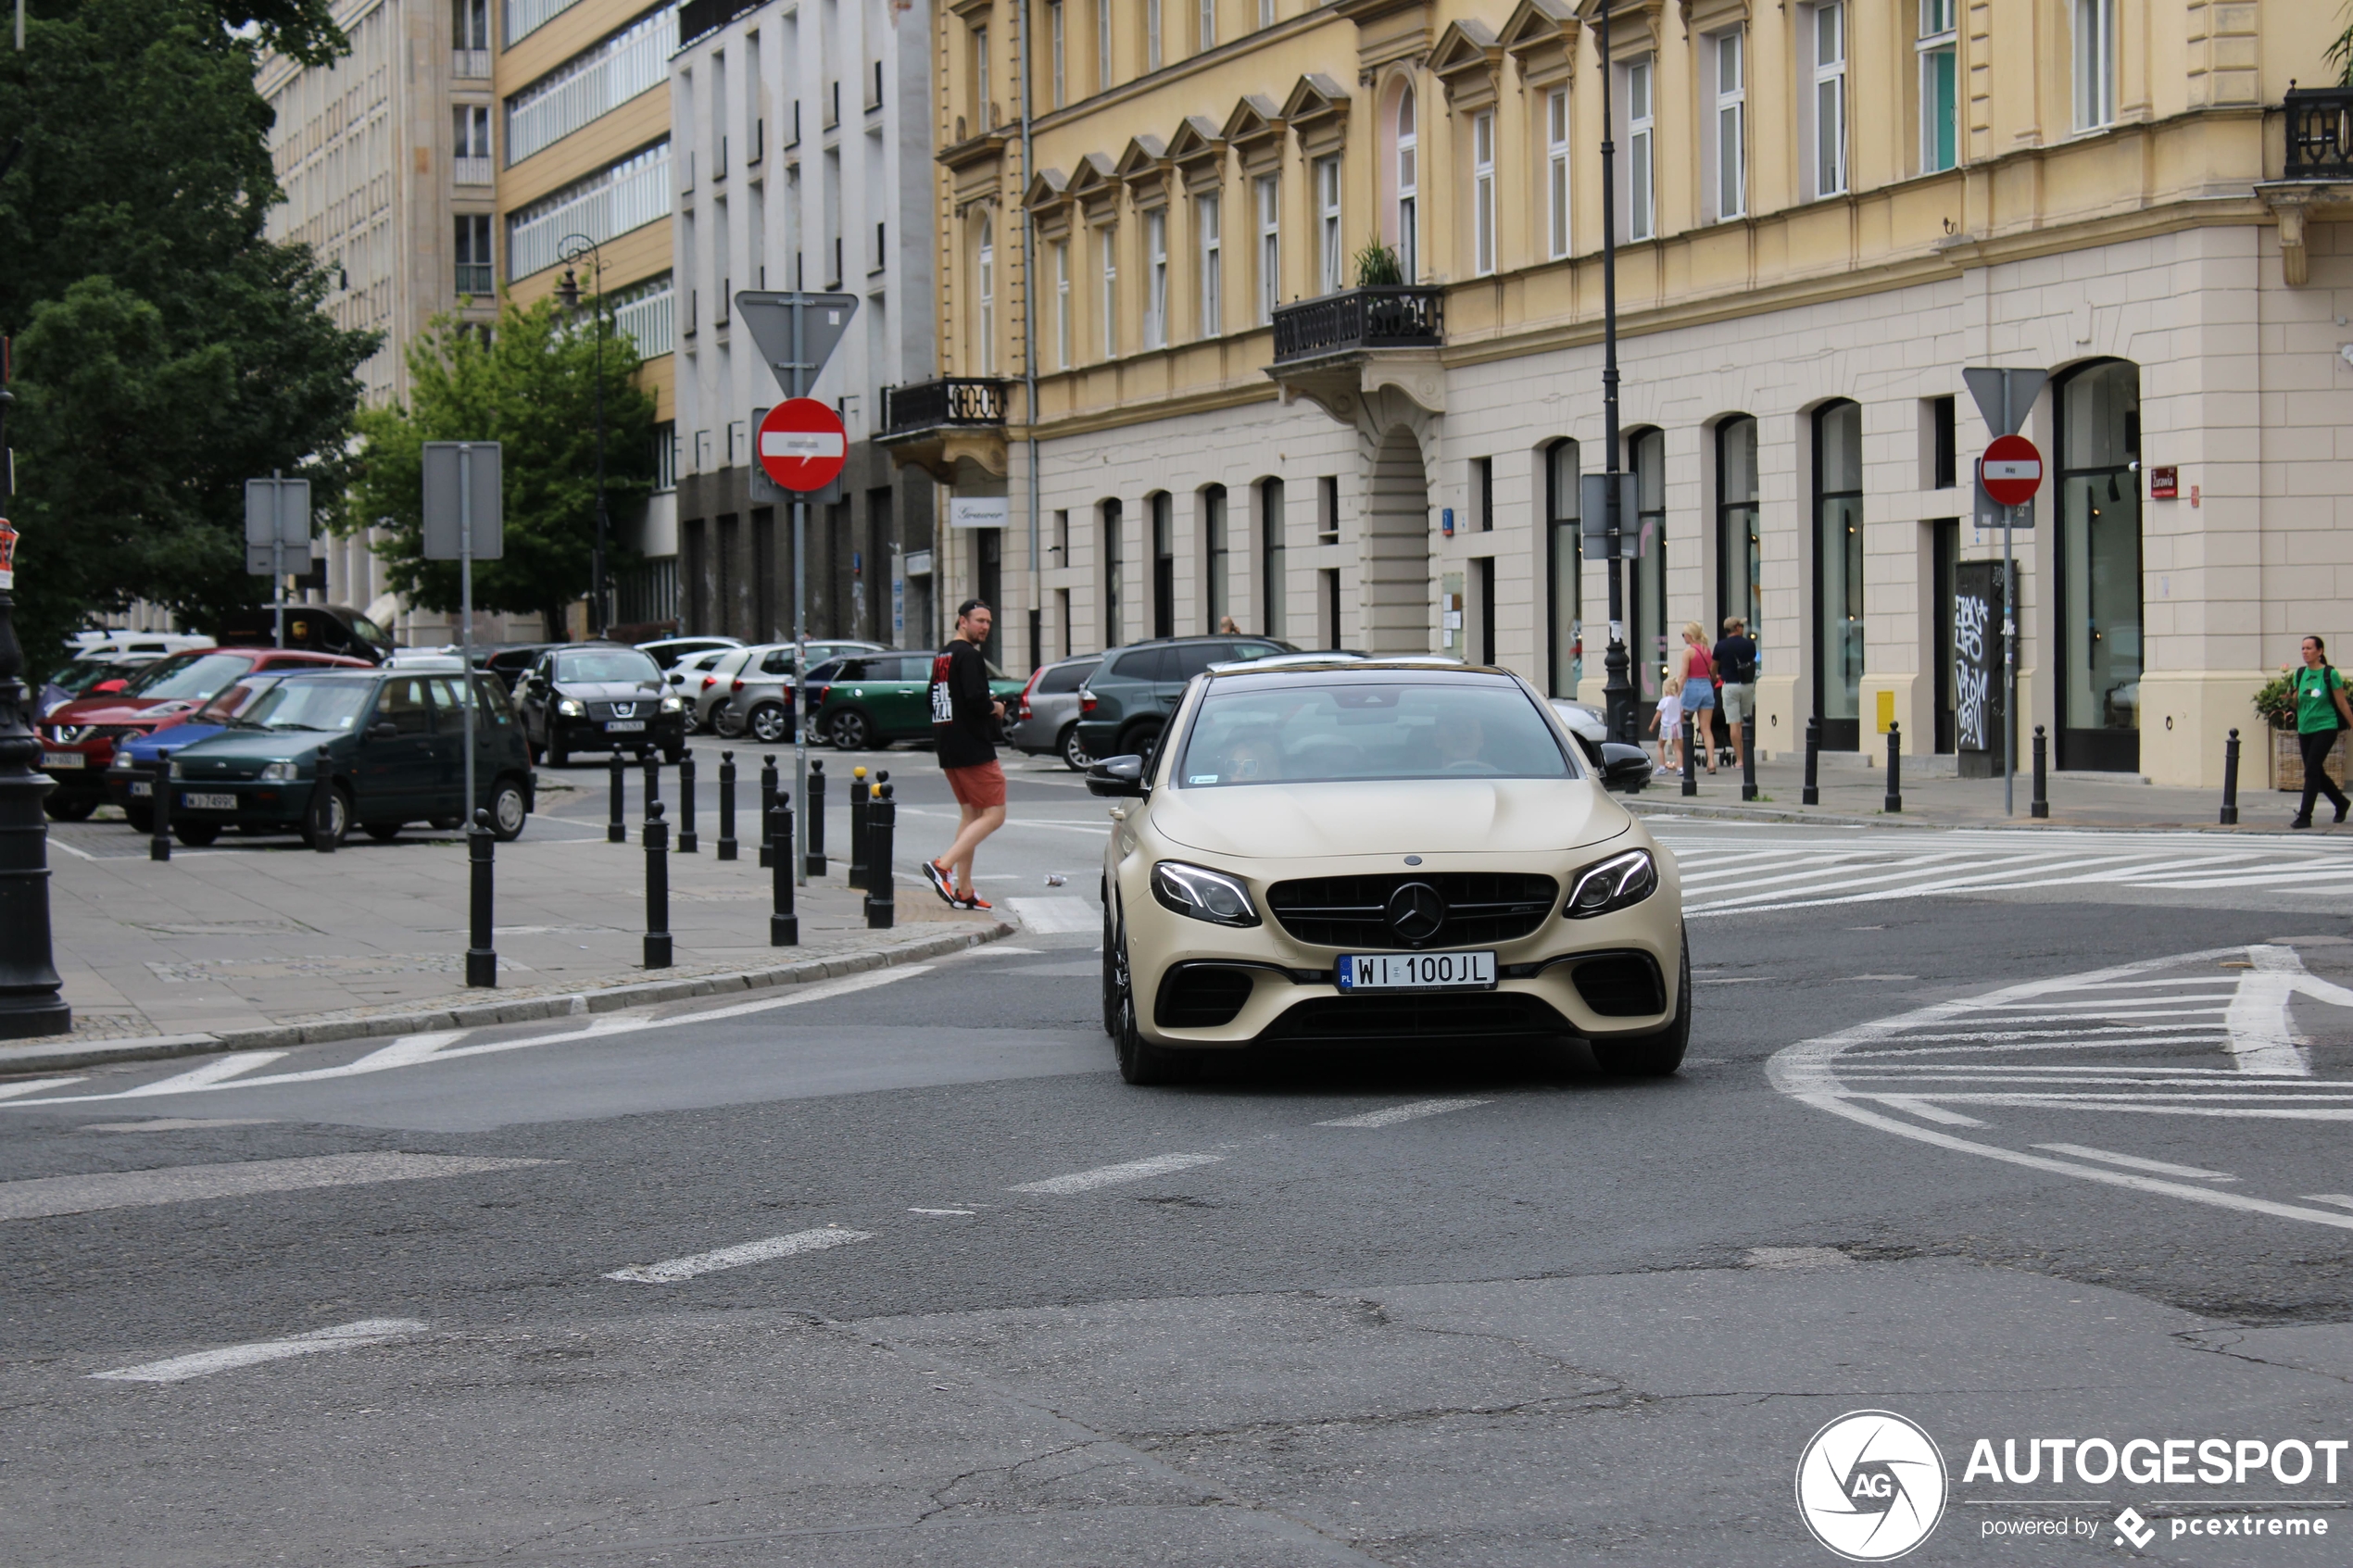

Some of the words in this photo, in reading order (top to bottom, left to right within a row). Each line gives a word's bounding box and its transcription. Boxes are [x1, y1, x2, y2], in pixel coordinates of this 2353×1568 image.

[2152, 474, 2173, 488] Żurawia
[1358, 958, 1388, 985] WI
[1406, 955, 1488, 984] 100JL
[1341, 975, 1352, 984] PL
